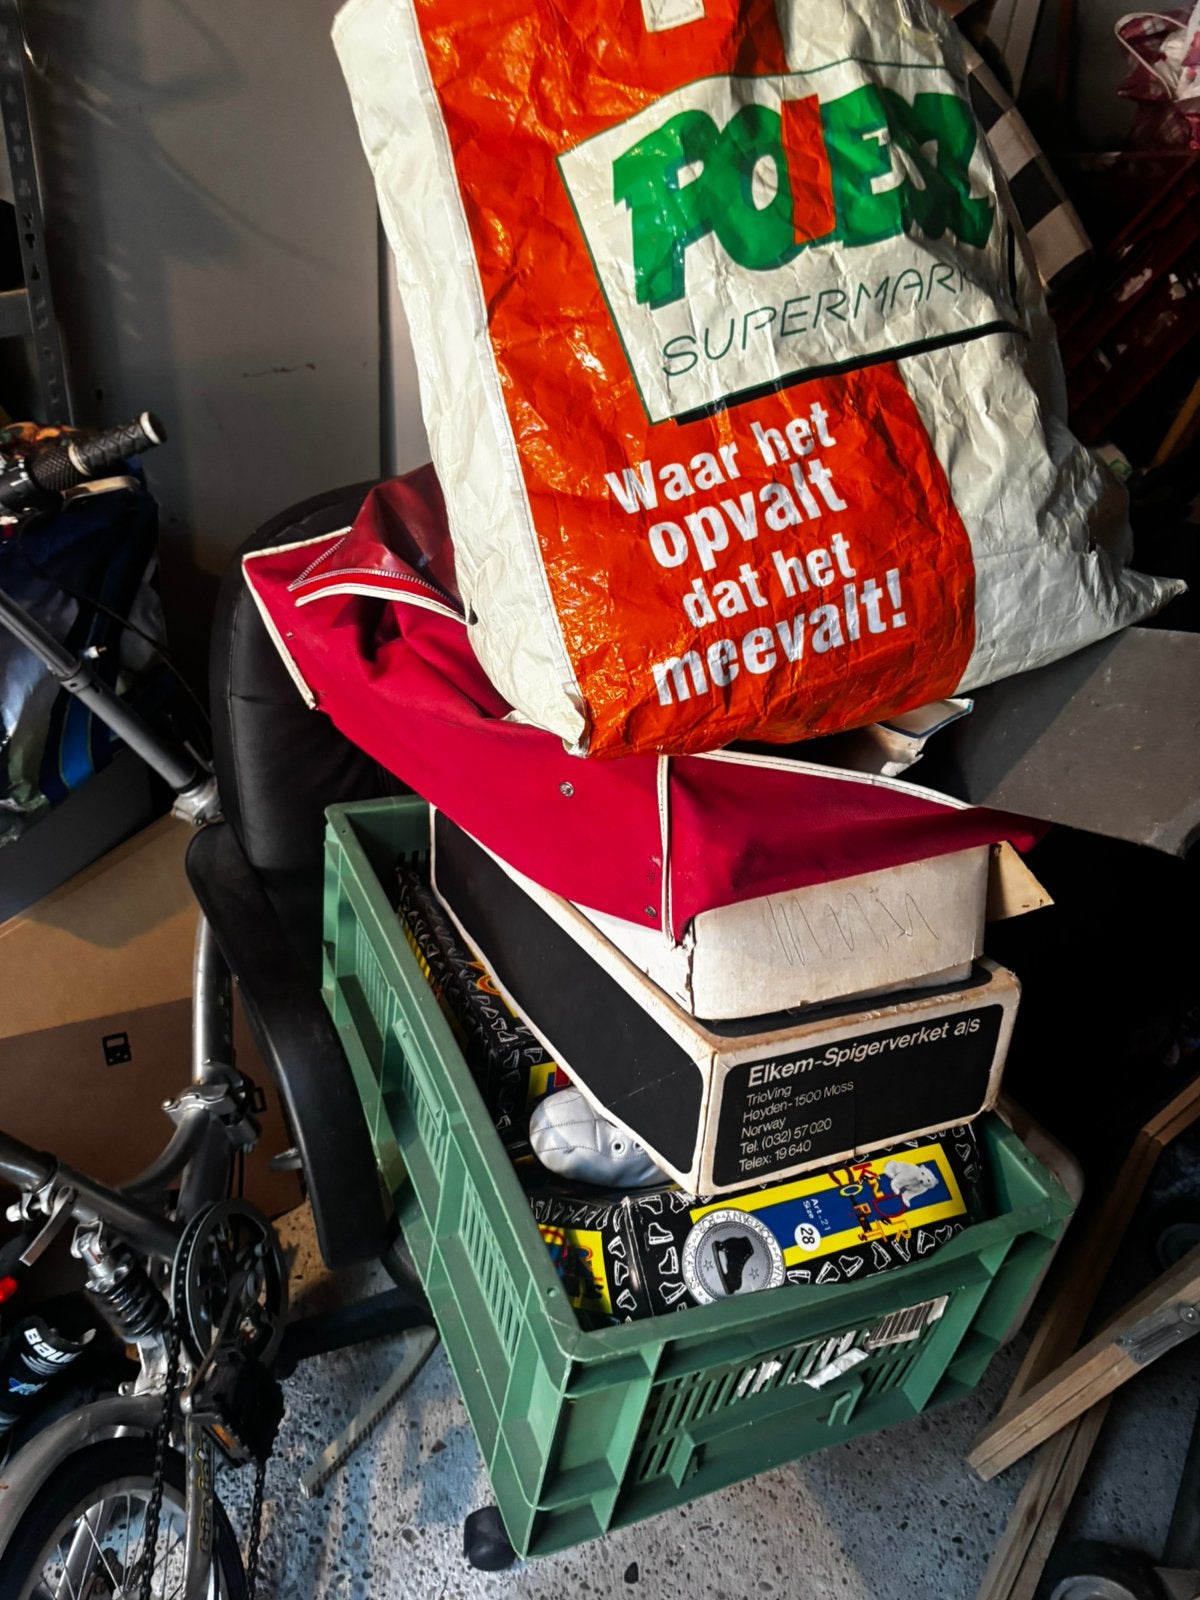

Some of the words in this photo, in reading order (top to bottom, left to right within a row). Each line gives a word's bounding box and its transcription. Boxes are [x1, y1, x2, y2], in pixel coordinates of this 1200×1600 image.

[604, 441, 741, 514] Waar
[751, 402, 837, 466] het
[648, 459, 848, 571] opvalt
[682, 564, 768, 628] dat
[772, 533, 856, 597] het
[652, 568, 907, 706] meevalt!
[748, 1022, 950, 1087] Elkem-Spigerverket
[953, 1017, 980, 1037] a/s
[746, 1085, 792, 1106] TrioVing
[794, 1089, 821, 1107] 1500
[823, 1081, 854, 1098] Moss
[740, 1139, 759, 1155] Tel.
[761, 1128, 791, 1150] (032)
[741, 1116, 786, 1139] Norway
[738, 1155, 772, 1172] Telex:
[695, 1215, 716, 1233] FOR
[725, 1211, 774, 1245] COMPANY
[800, 1226, 815, 1245] 28
[687, 1243, 700, 1289] SKATES
